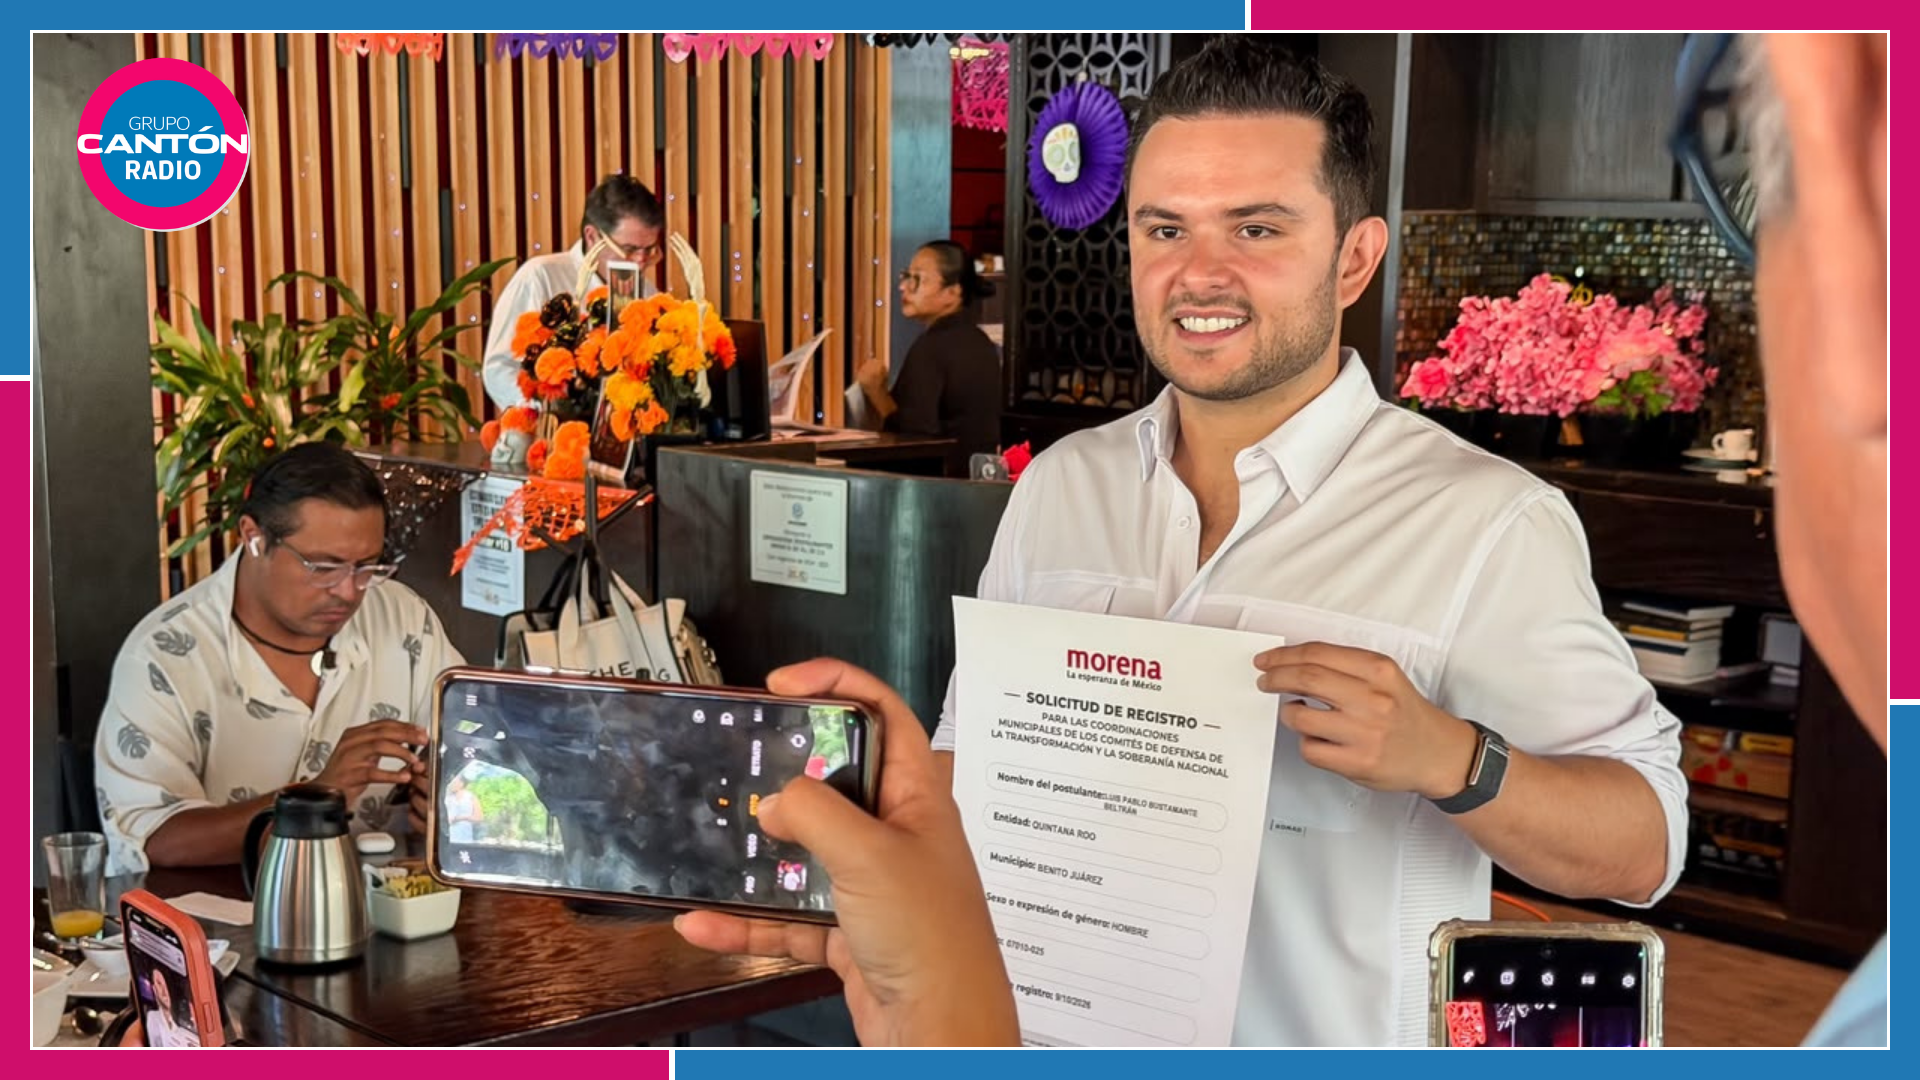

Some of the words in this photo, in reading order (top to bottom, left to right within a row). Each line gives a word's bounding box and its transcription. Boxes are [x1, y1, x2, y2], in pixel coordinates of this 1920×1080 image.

[1066, 670, 1076, 679] La
[1078, 672, 1118, 686] esperanza
[1120, 677, 1130, 687] de
[1132, 678, 1162, 691] México
[1067, 649, 1162, 680] morena
[1026, 692, 1100, 714] SOLICITUD
[1104, 703, 1123, 718] DE
[1127, 707, 1198, 730] REGISTRO
[1041, 712, 1068, 724] PARA
[1070, 716, 1088, 728] LAS
[1090, 719, 1179, 743] COORDINACIONES
[990, 729, 1003, 739] LA
[1004, 731, 1094, 755] TRANSFORMACIÓN
[1095, 746, 1102, 756] Y
[1104, 747, 1117, 758] LA
[1118, 750, 1175, 768] SOBERANÍA
[1177, 760, 1229, 779] NACIONAL
[998, 718, 1062, 736] MUNICIPALES
[1064, 728, 1078, 740] DE
[1079, 731, 1098, 742] LOS
[1100, 734, 1143, 751] COMITÉS
[1145, 742, 1159, 753] DE
[1160, 745, 1207, 761] DEFENSA
[1209, 753, 1224, 764] DE
[997, 772, 1034, 787] Nombre
[1036, 779, 1051, 790] del
[1123, 795, 1147, 808] PABLO
[1149, 801, 1198, 818] BUSTAMANTE
[993, 811, 1031, 828] Entidad:
[1032, 820, 1075, 838] QUINTANA
[1076, 829, 1096, 841] ROO
[990, 851, 1036, 870] Municipio:
[1037, 863, 1068, 878] BENITO
[1070, 867, 1104, 886] JUÁREZ
[986, 891, 1007, 905] Sexo
[1008, 899, 1015, 907] o
[1016, 901, 1060, 917] expresión
[1061, 909, 1074, 920] de
[1075, 912, 1111, 929] género:
[1111, 922, 1149, 938] HOMBRE
[1016, 983, 1054, 1000] registro:
